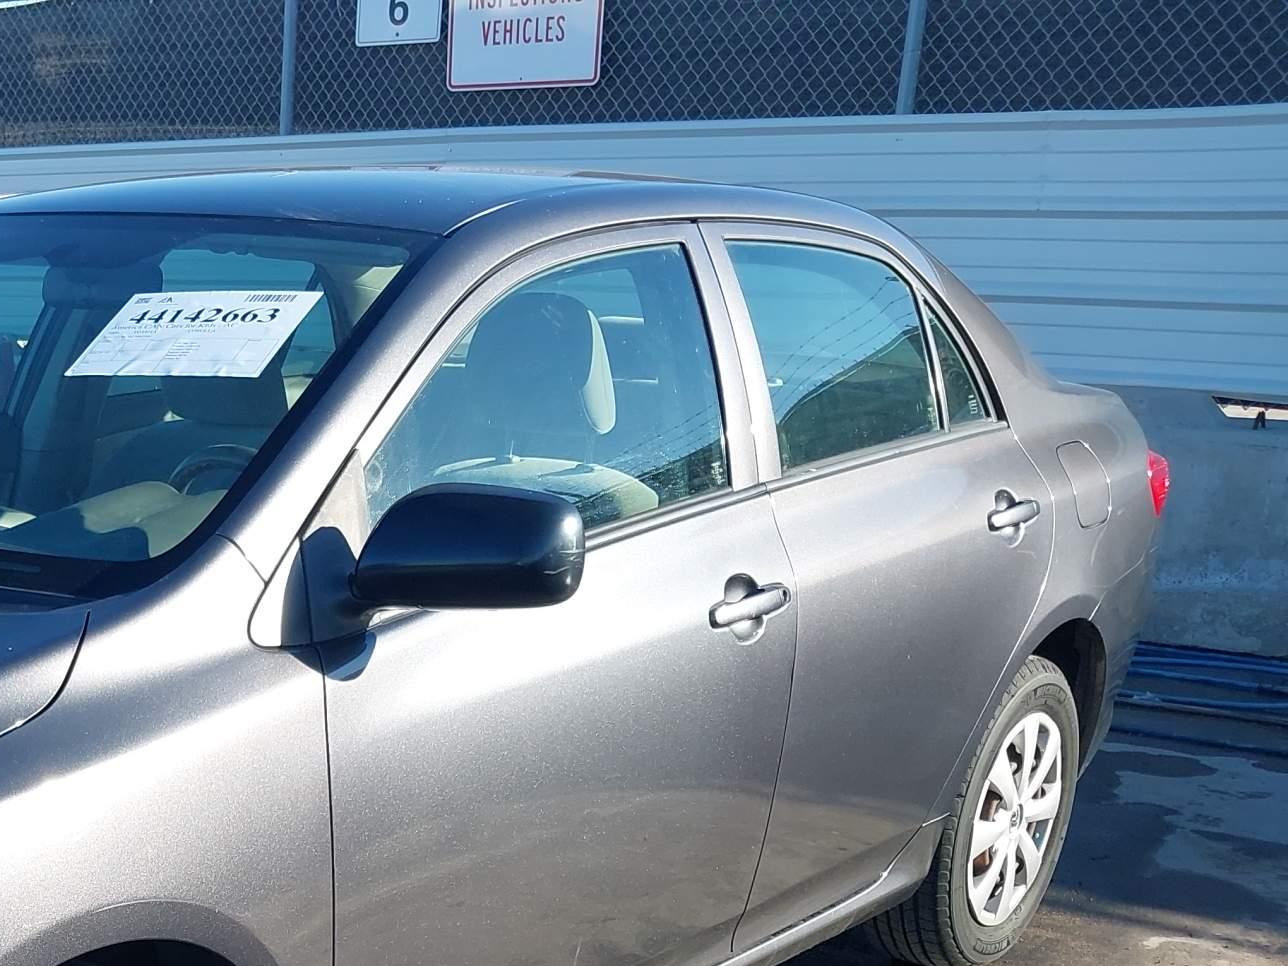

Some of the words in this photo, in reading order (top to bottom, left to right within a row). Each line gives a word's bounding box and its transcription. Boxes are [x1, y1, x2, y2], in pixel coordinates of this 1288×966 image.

[389, 0, 409, 26] 6
[481, 15, 567, 47] VEHICLES
[129, 307, 281, 324] 44142663
